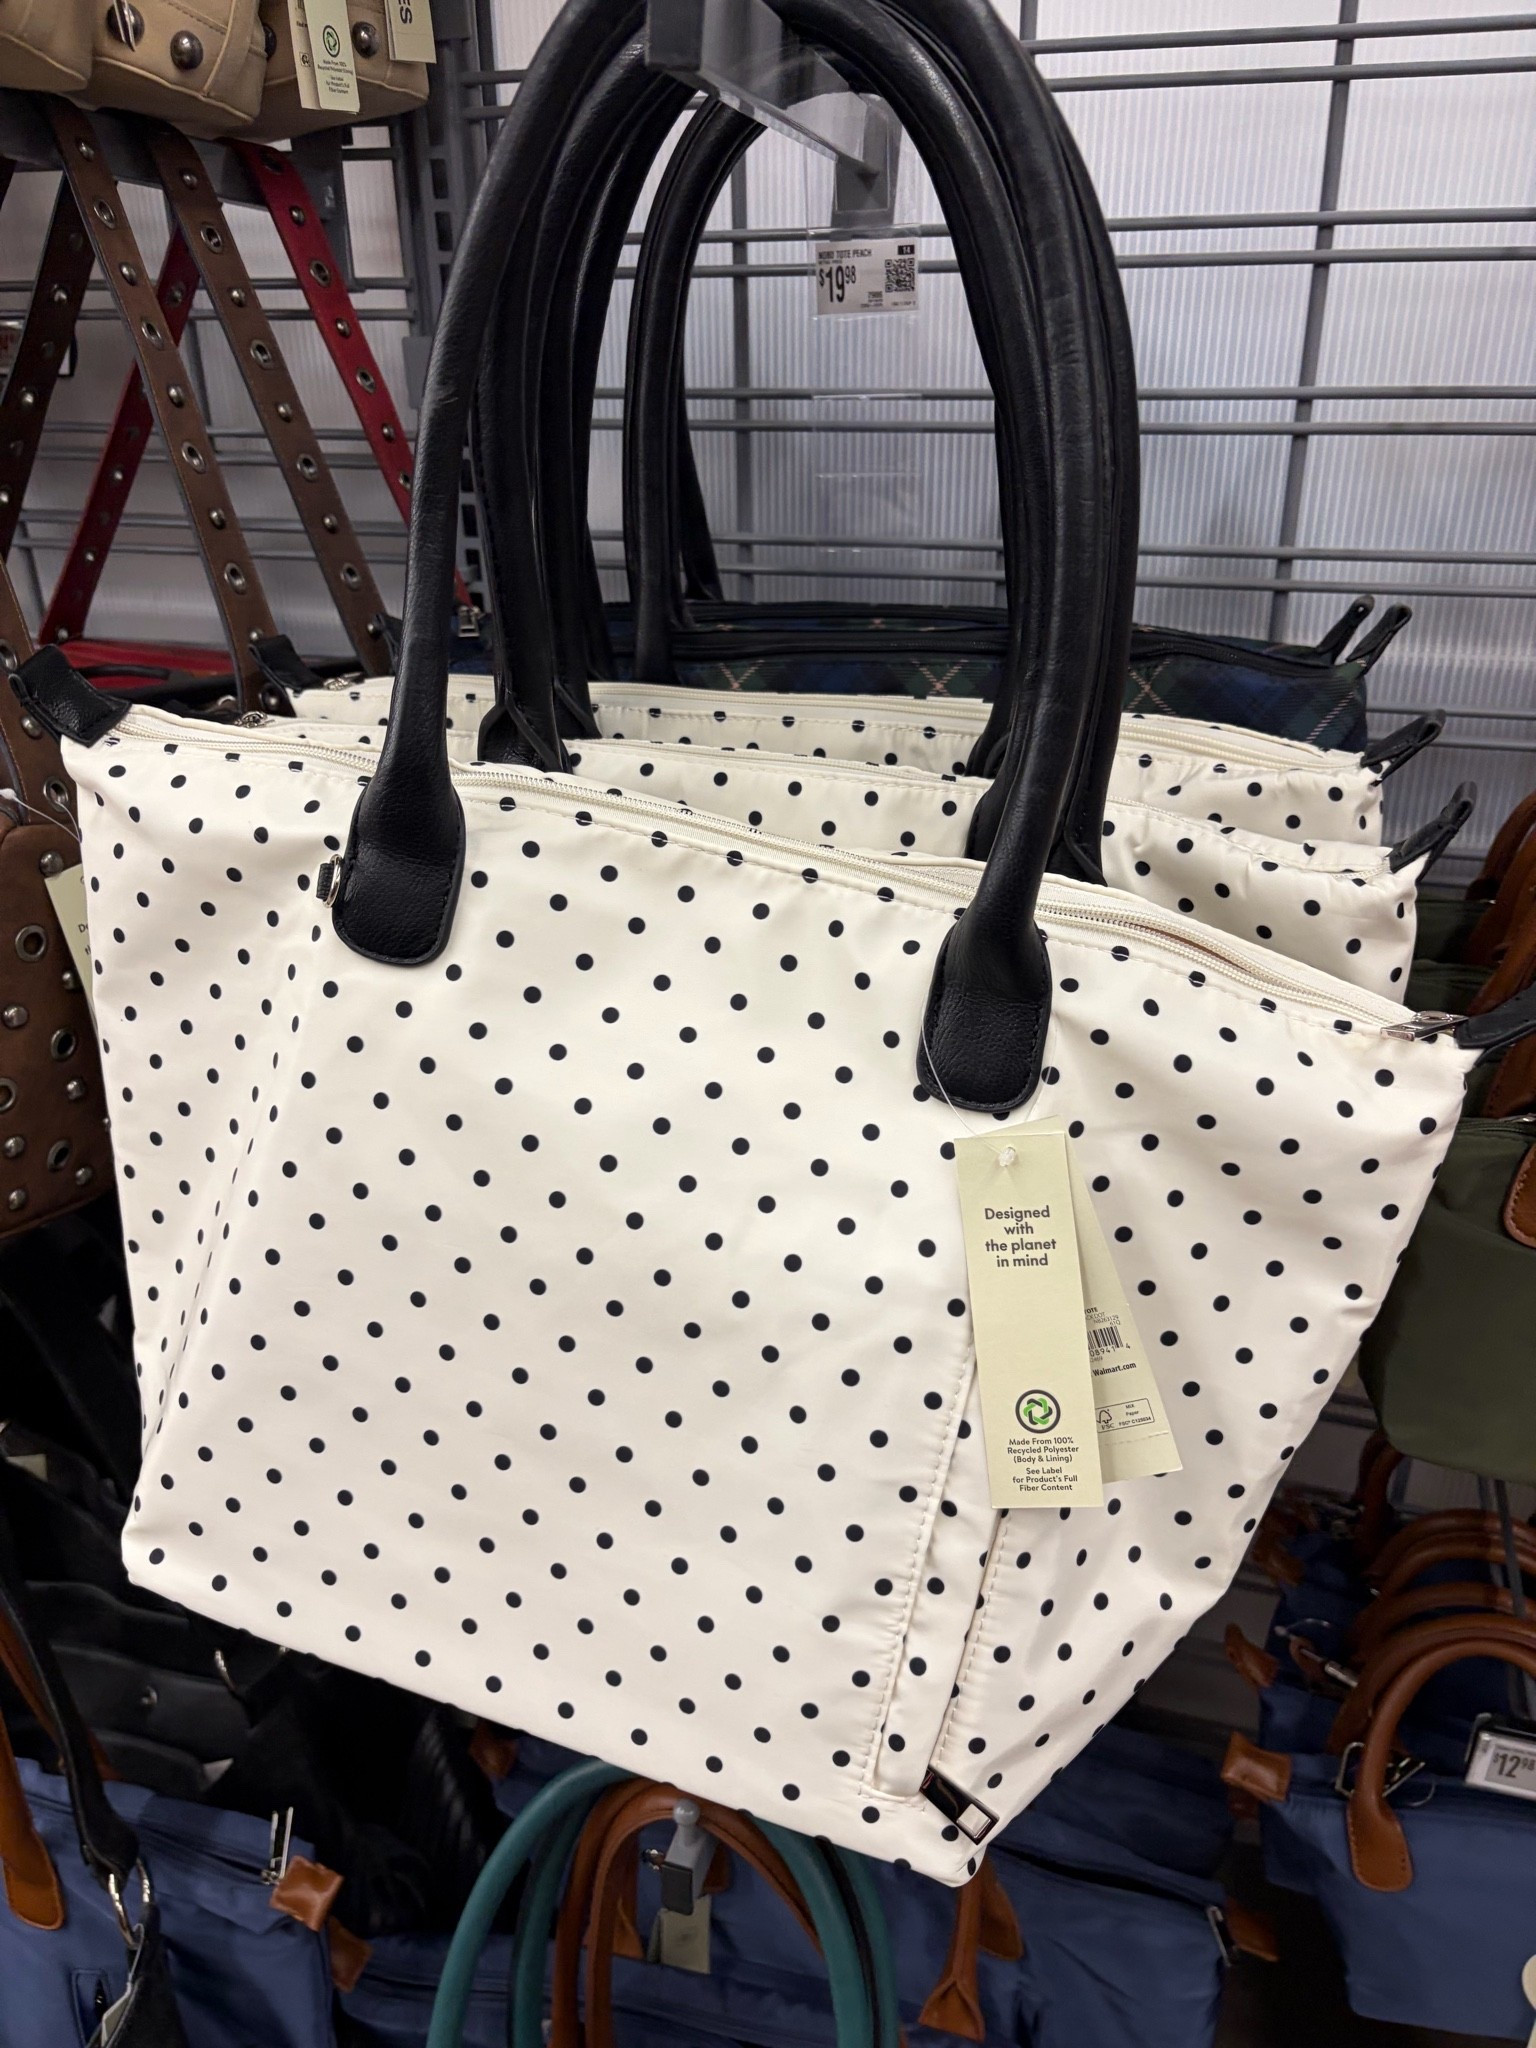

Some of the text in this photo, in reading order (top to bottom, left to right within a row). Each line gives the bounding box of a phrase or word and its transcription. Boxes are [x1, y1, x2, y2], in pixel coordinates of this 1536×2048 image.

[853, 249, 872, 258] PEACH
[984, 1205, 1050, 1222] Designed
[1004, 1222, 1034, 1235] with
[985, 1238, 1057, 1254] the planet
[996, 1253, 1048, 1267] in mind
[1092, 1362, 1137, 1377] Walmart.com
[1009, 1436, 1074, 1446] Made From 100%
[1007, 1446, 1079, 1455] Recycled Polyester
[1013, 1455, 1036, 1464] (Body
[1046, 1454, 1073, 1463] Lining)
[1042, 1466, 1062, 1474] Label
[1026, 1475, 1062, 1483] Product's
[1041, 1483, 1073, 1491] Content
